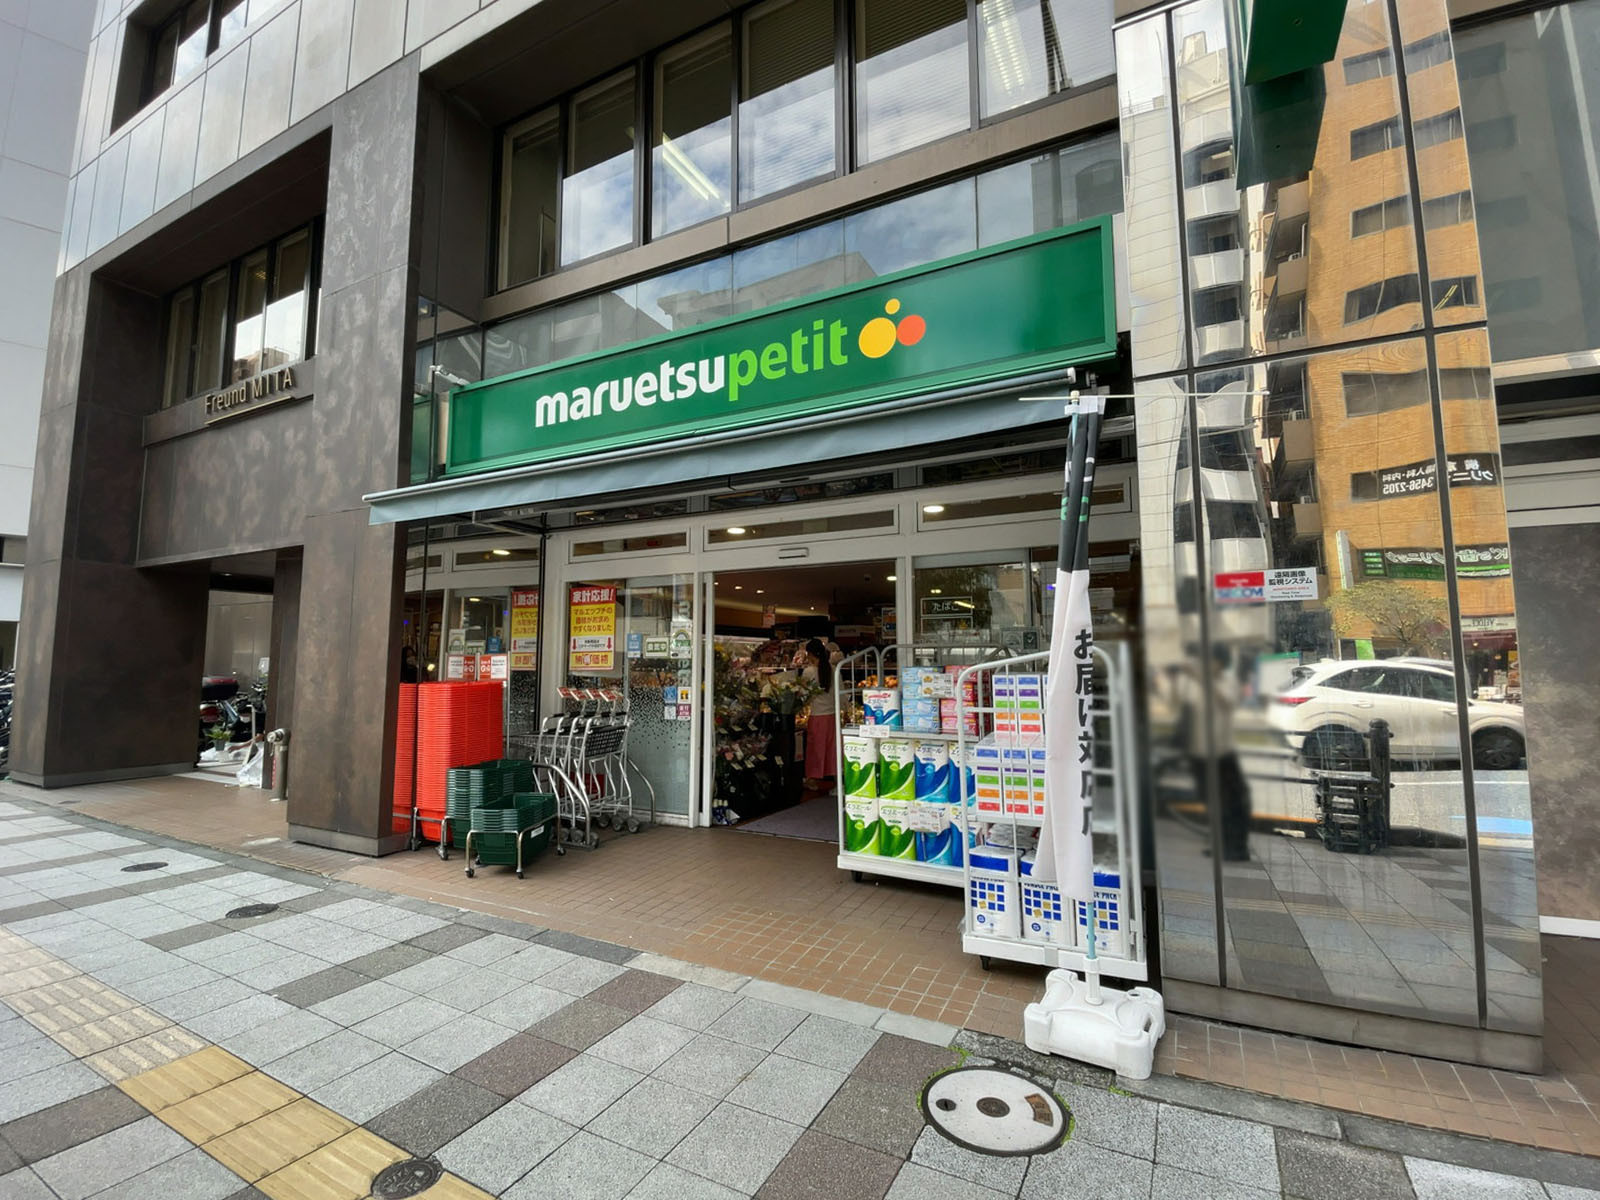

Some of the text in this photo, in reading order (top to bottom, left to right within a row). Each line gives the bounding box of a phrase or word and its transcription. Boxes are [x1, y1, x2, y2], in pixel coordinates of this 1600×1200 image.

[204, 368, 293, 414] Freund MITA
[1274, 570, 1306, 578] 遠隔画像
[1268, 577, 1313, 586] 監視システム
[933, 601, 959, 612] たばこ
[572, 624, 613, 634] やすくなりました
[881, 743, 909, 753] エリエール
[917, 744, 943, 754] エリエール
[881, 808, 909, 817] エリエール
